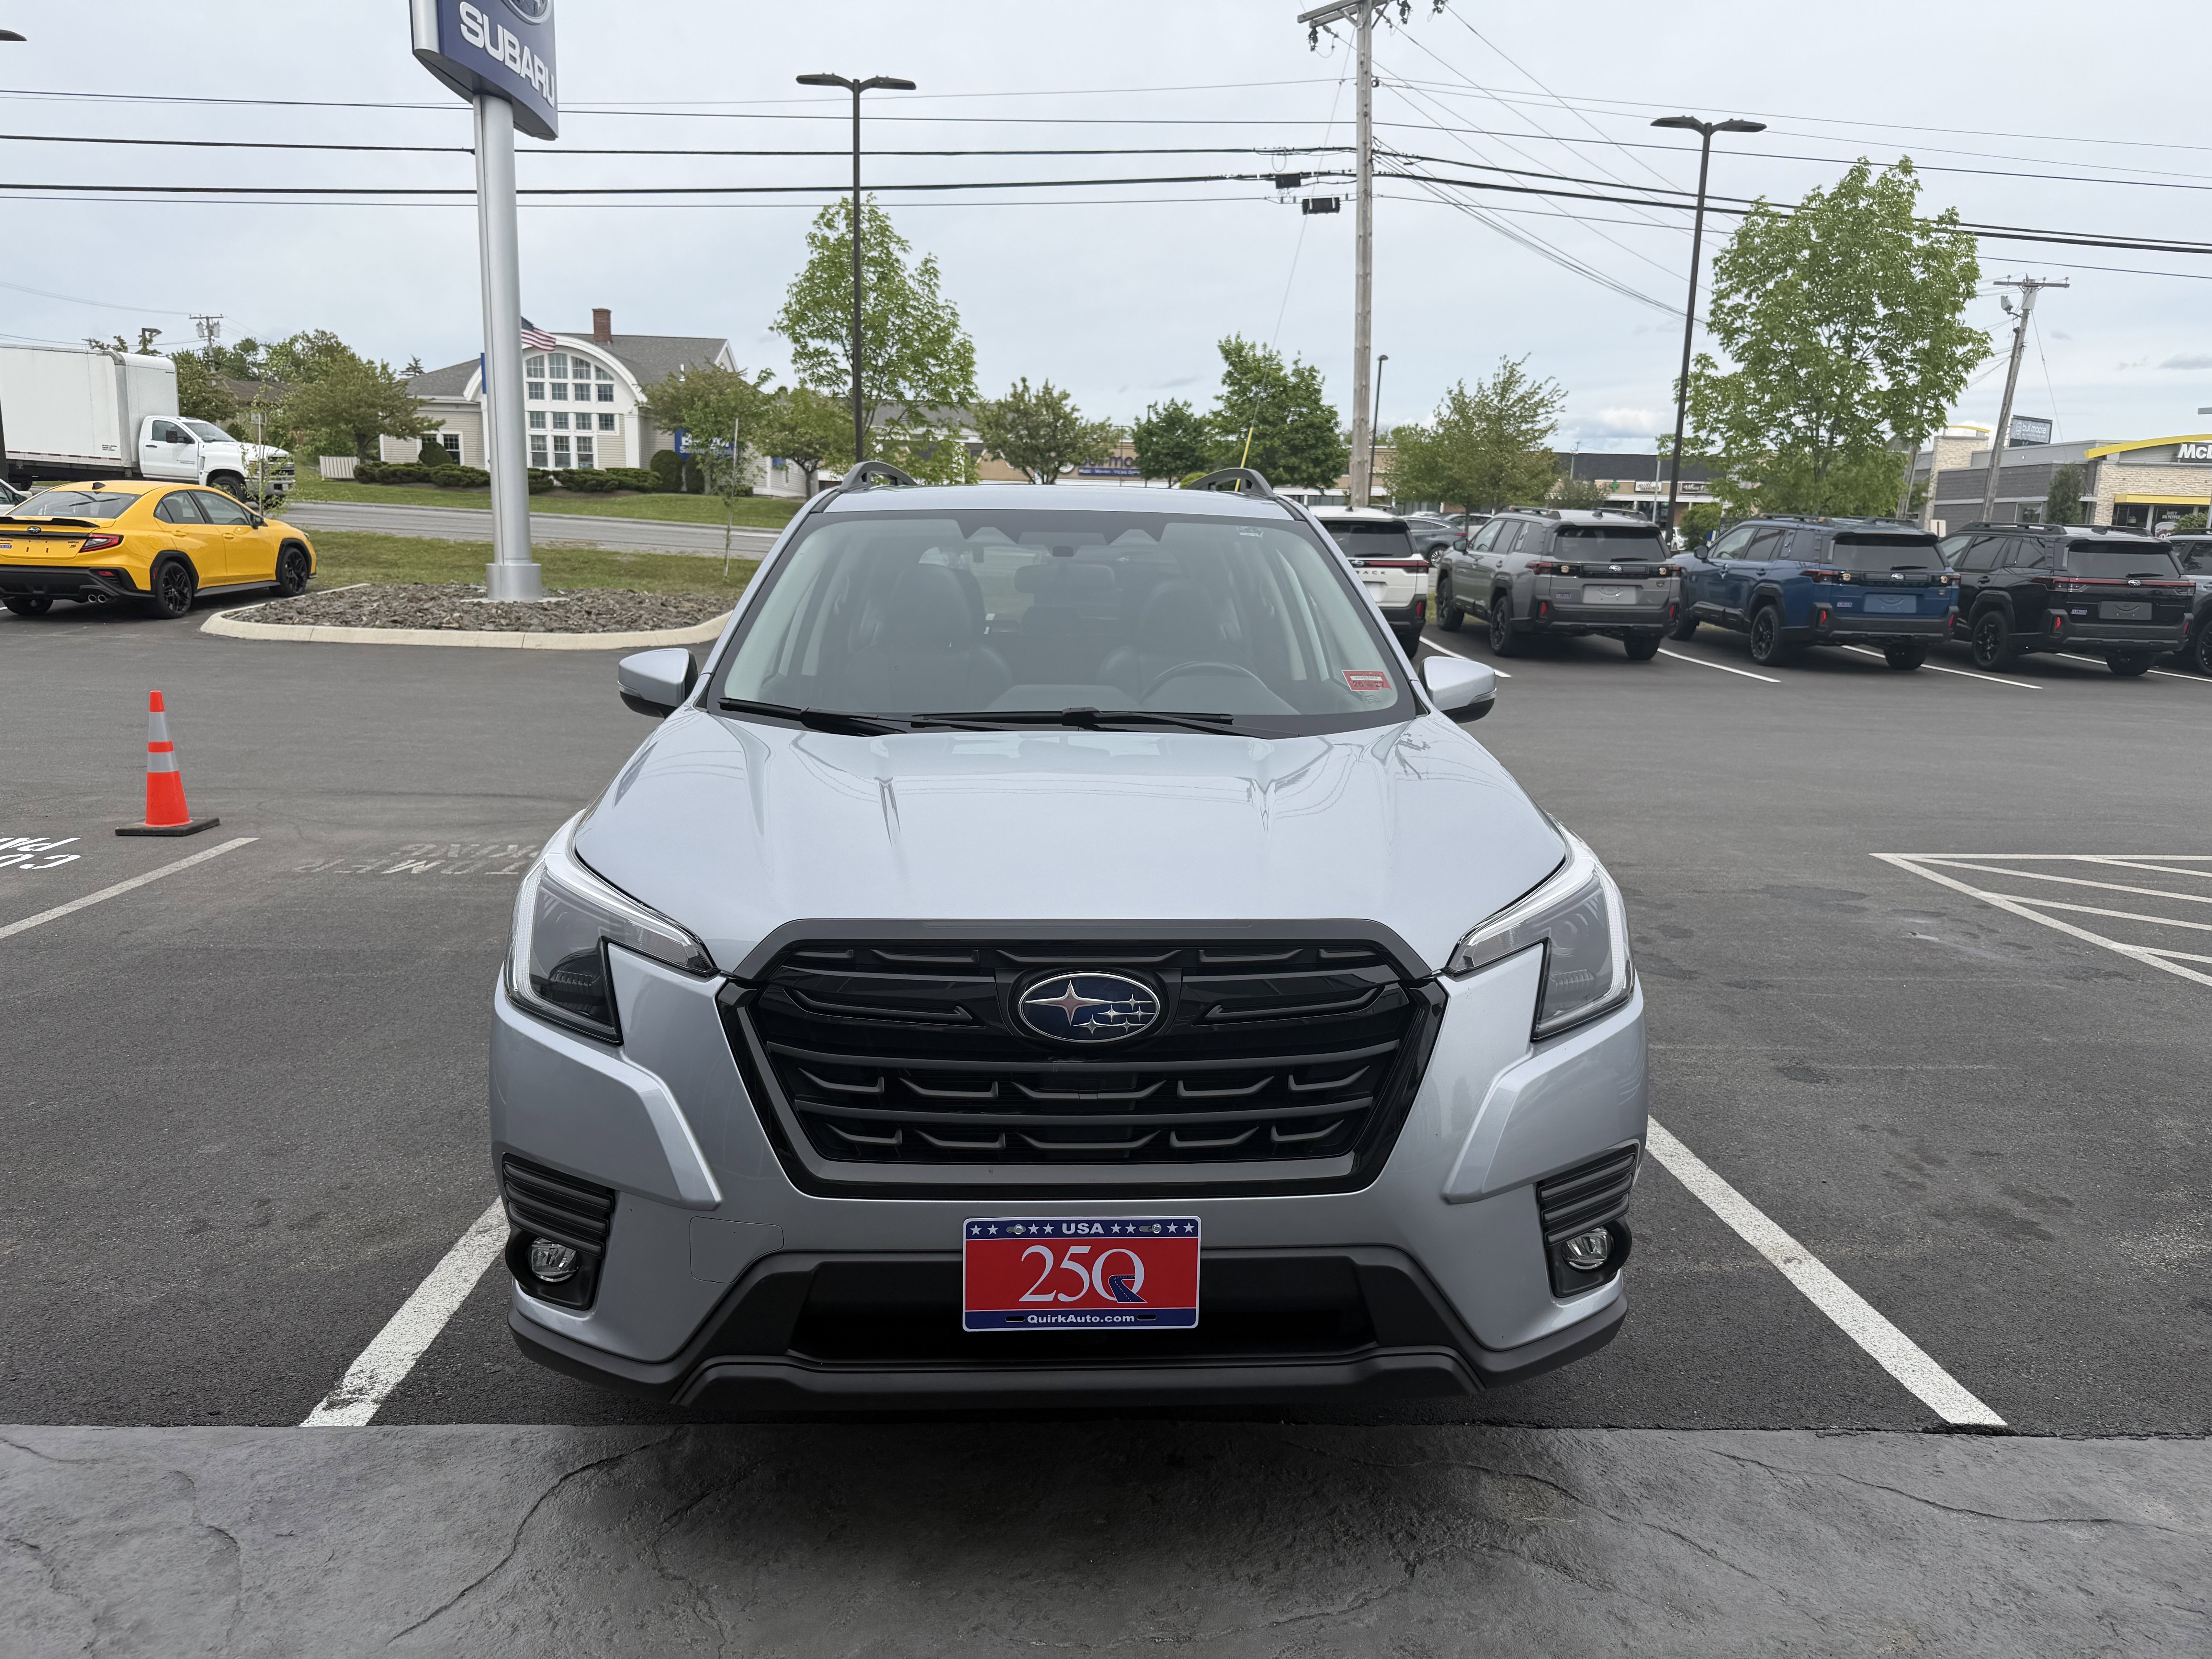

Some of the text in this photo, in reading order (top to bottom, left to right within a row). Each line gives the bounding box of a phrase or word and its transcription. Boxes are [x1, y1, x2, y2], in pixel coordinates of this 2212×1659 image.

[459, 1, 555, 108] SUBARU
[2031, 426, 2046, 434] moose
[1061, 1223, 1104, 1235] USA
[1027, 1314, 1135, 1324] QuirkAuto.com
